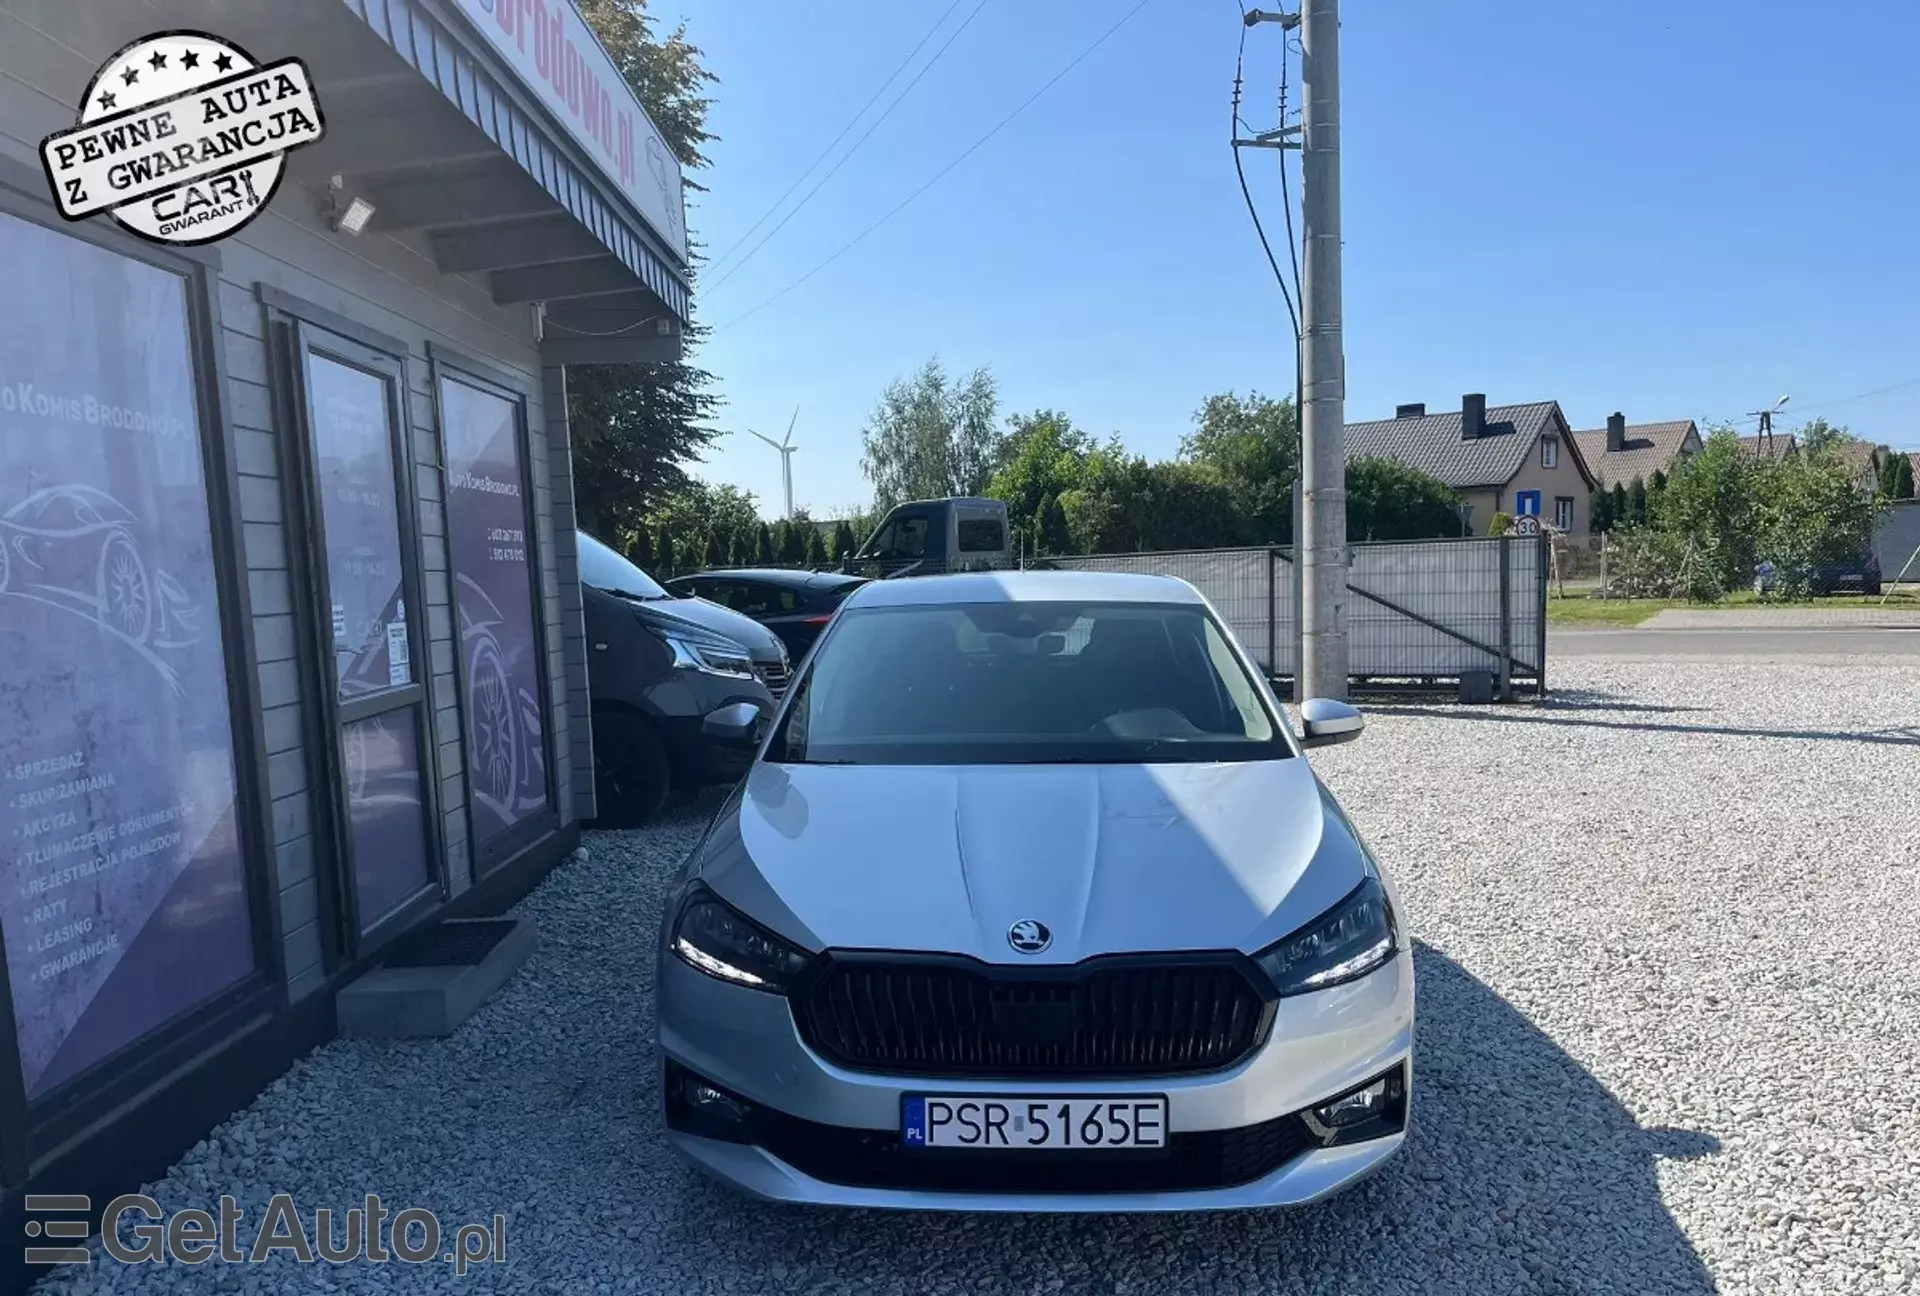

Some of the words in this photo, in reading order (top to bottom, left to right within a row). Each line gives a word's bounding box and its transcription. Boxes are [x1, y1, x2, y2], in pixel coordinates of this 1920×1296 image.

[1520, 521, 1538, 534] 30
[15, 749, 85, 781] SPRZEDAŻ
[23, 810, 78, 838] AKCYZA
[29, 853, 119, 896] REJESTRACJA
[32, 898, 68, 925] RATY
[36, 917, 93, 952] LEASING
[907, 1128, 923, 1140] PL
[928, 1102, 1010, 1146] PSR
[1027, 1102, 1160, 1146] 5165E
